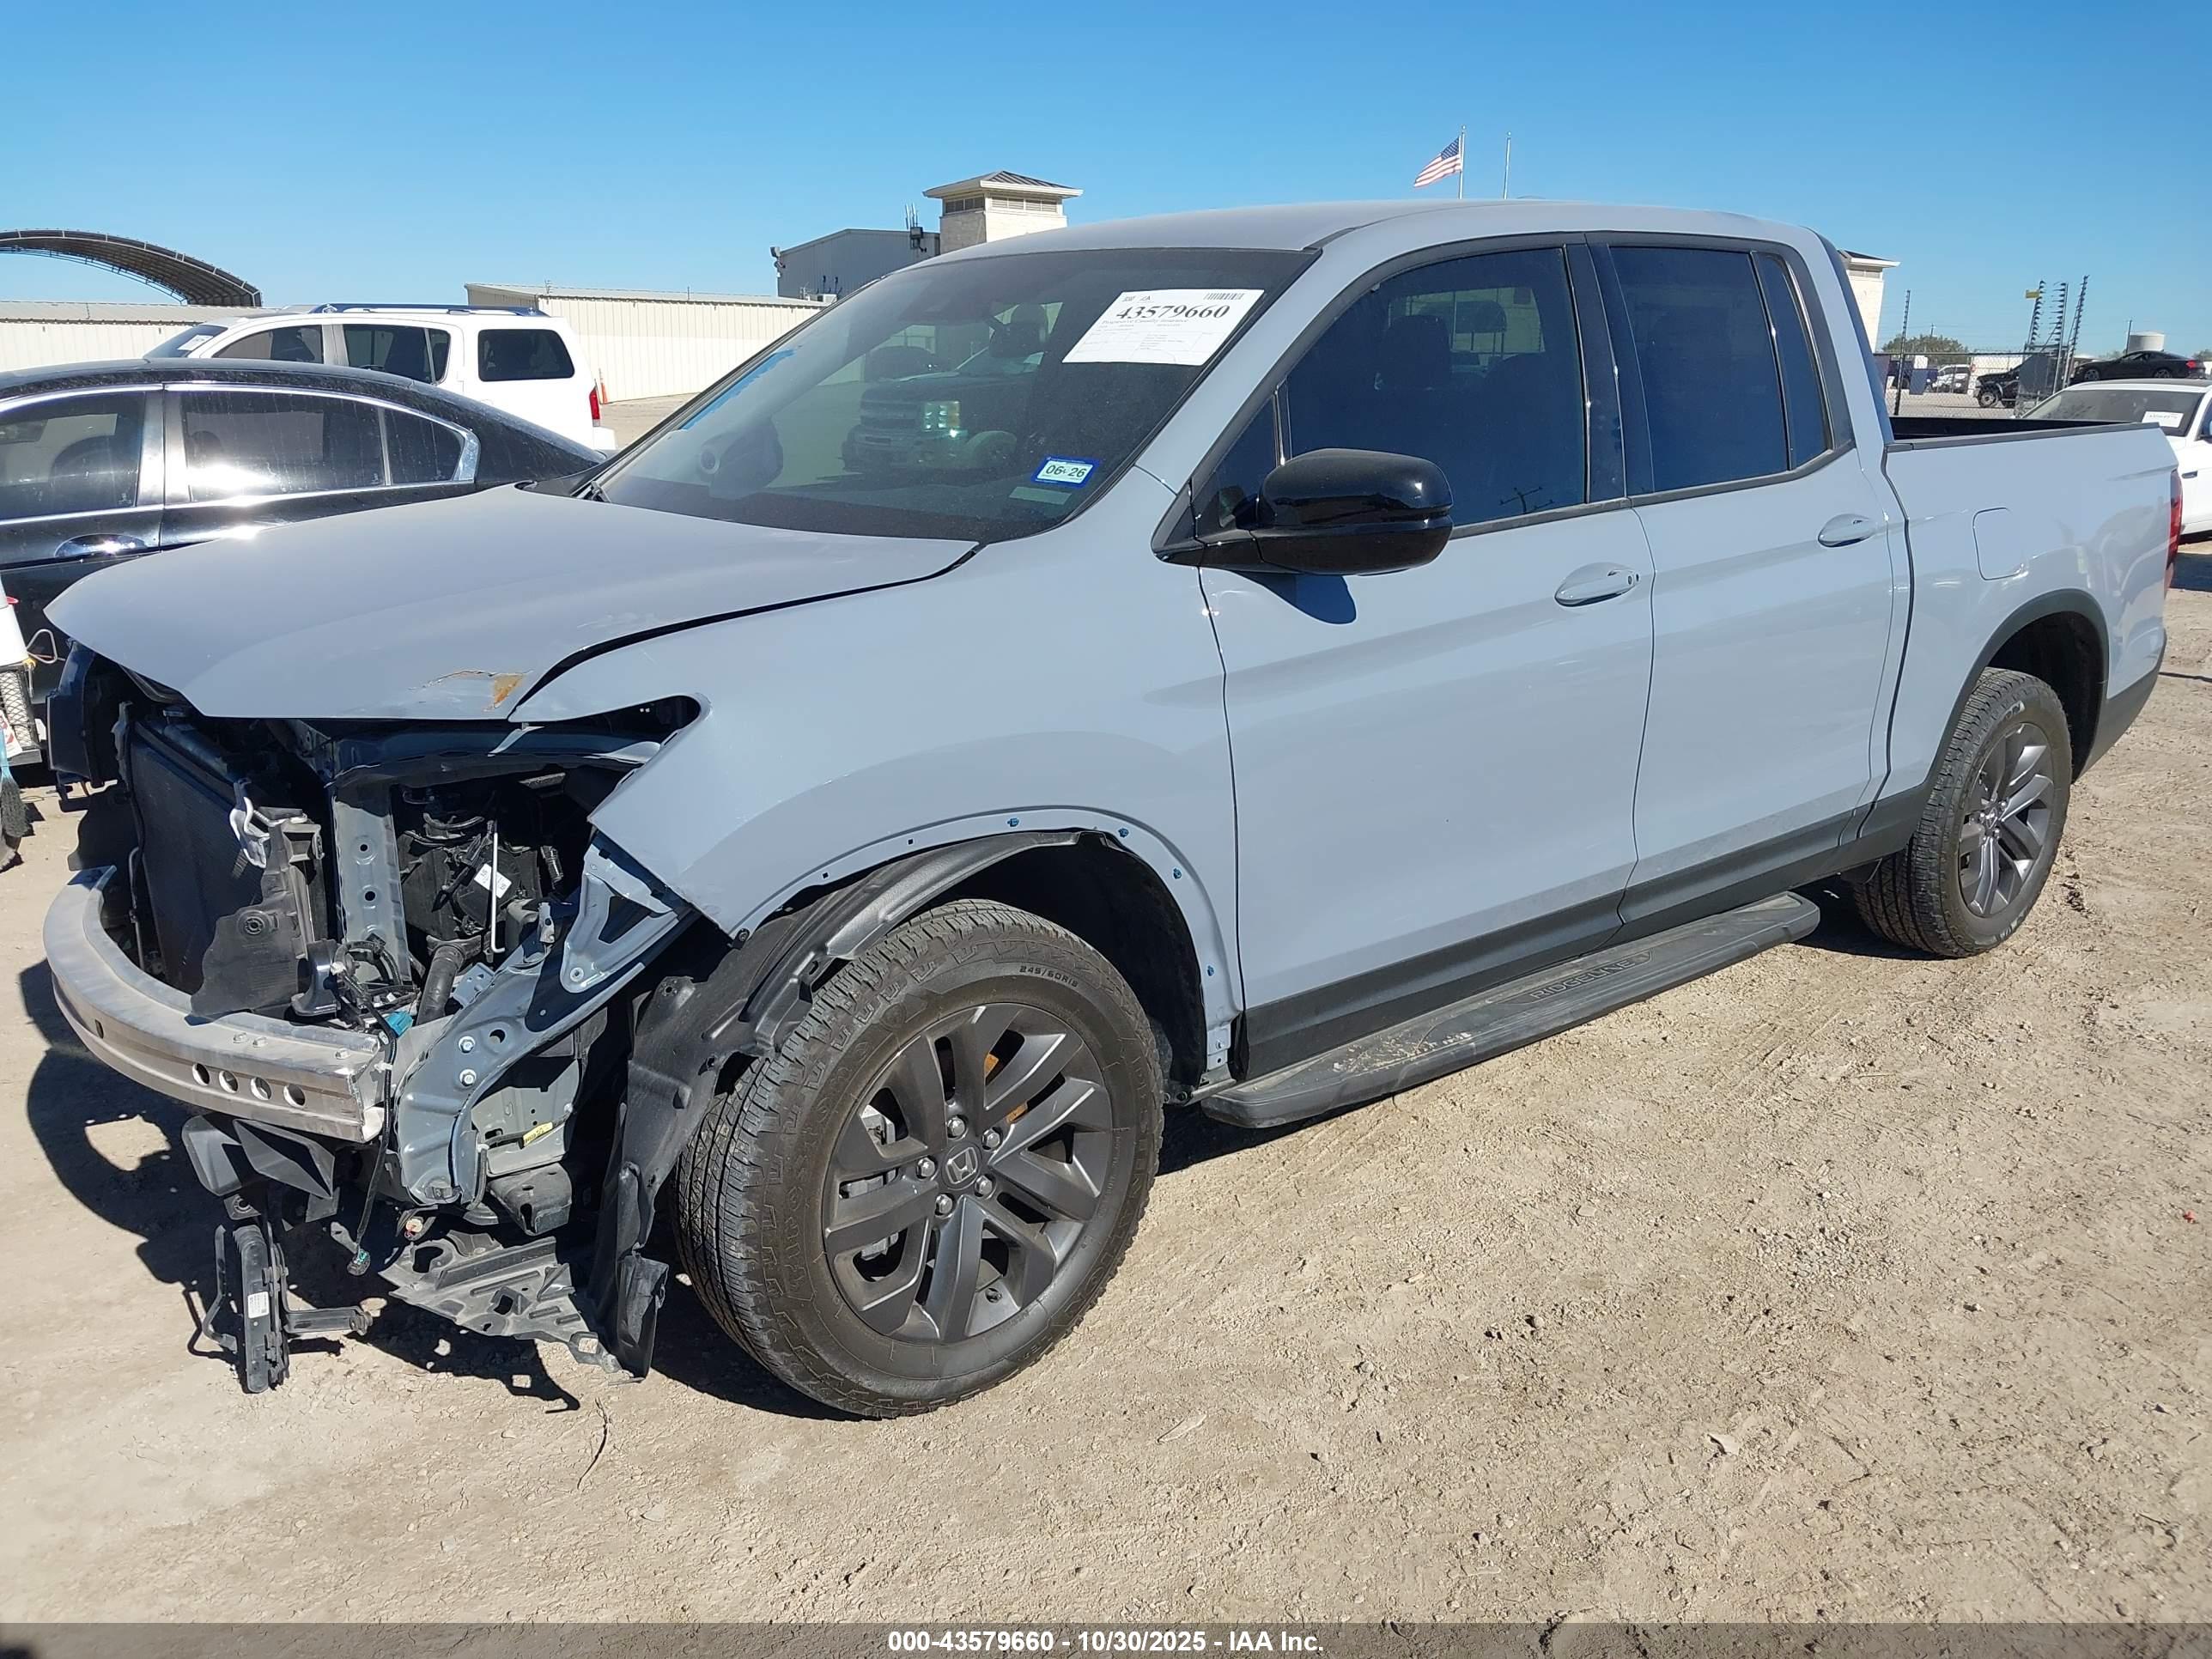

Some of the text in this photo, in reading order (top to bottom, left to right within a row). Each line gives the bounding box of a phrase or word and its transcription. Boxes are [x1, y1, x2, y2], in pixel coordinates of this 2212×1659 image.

[1115, 304, 1231, 319] 43579660
[1045, 465, 1087, 477] 06 26
[1018, 965, 1079, 988] 245/60R18
[1529, 959, 1636, 1000] RIDGELINE
